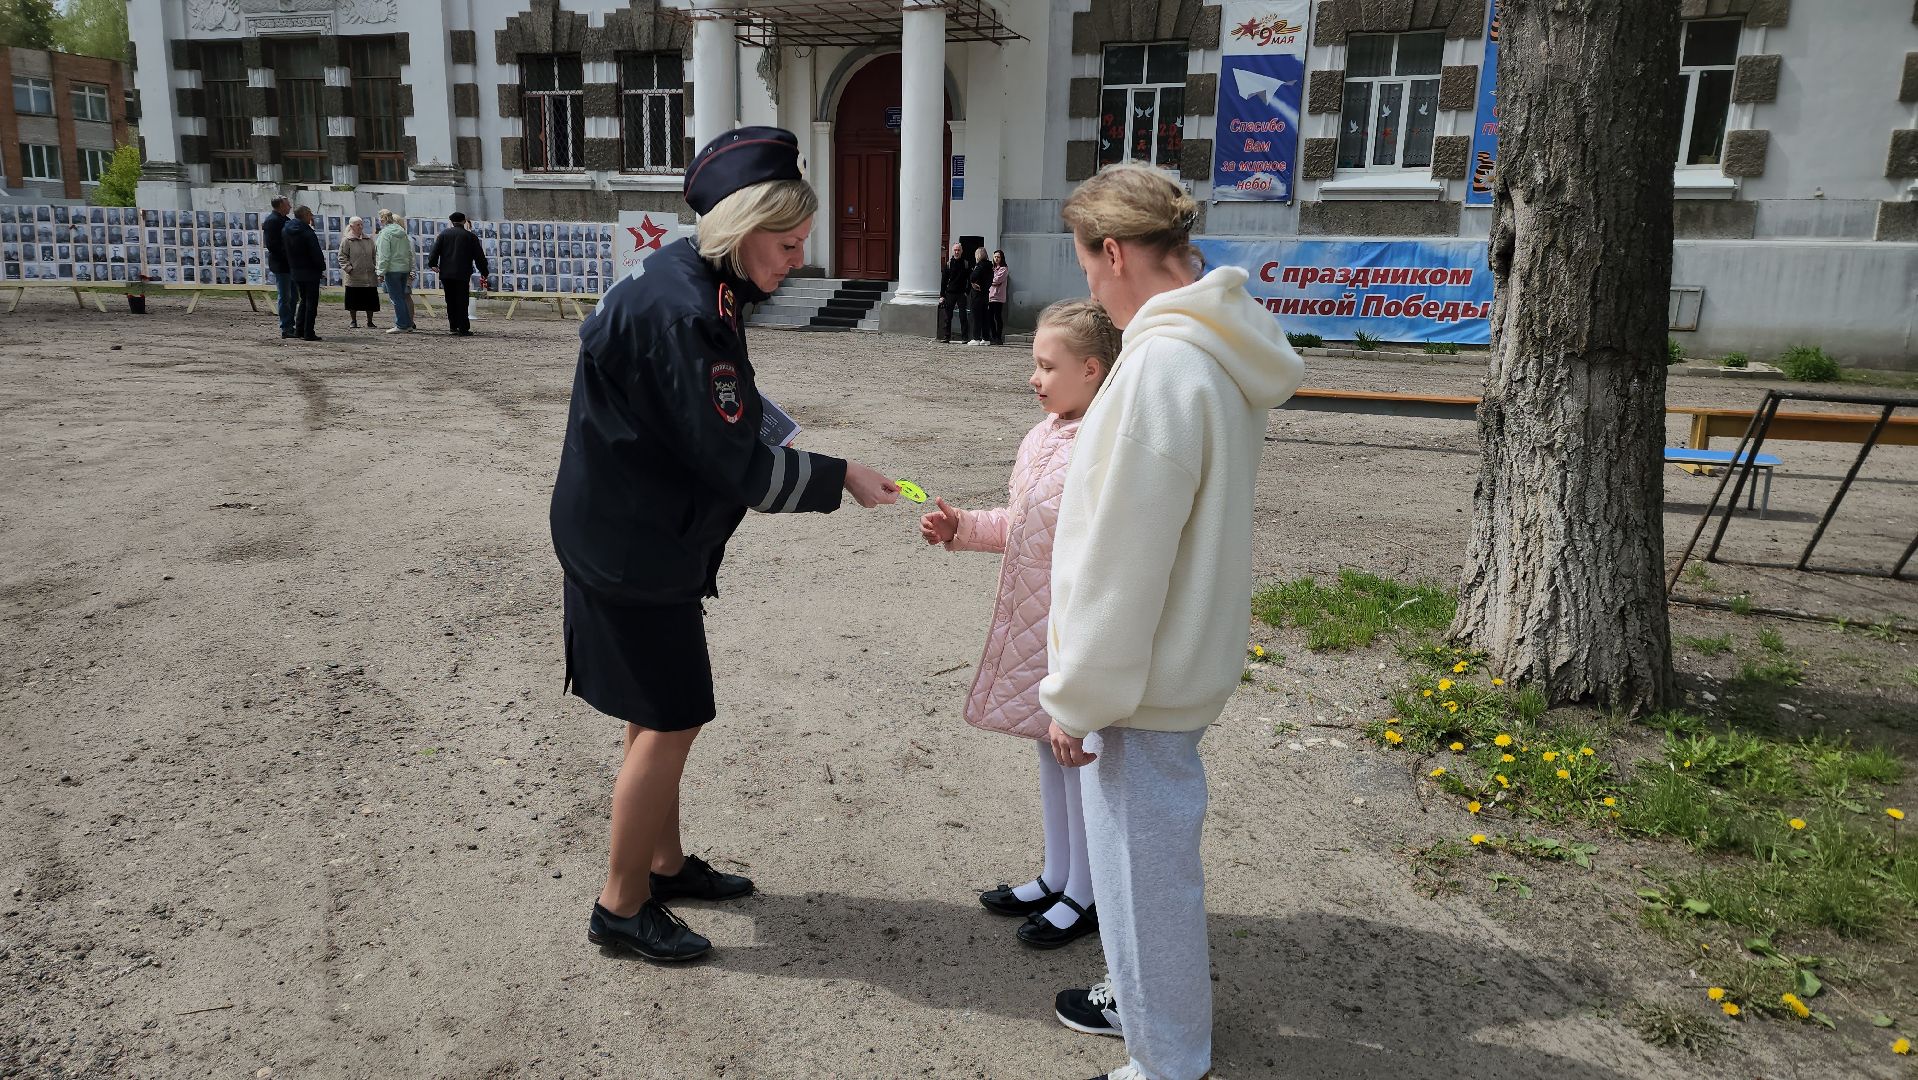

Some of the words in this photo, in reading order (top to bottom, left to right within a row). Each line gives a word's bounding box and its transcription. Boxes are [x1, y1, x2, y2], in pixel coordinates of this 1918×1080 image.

[1257, 27, 1273, 46] 9
[1271, 35, 1295, 45] МАЯ
[1230, 118, 1286, 132] Спасибо
[1243, 138, 1272, 152] Вам
[1221, 161, 1236, 171] за
[1238, 161, 1287, 173] мирное
[1235, 178, 1273, 191] небо!
[1260, 261, 1279, 283] С
[1281, 266, 1473, 289] праздником
[1253, 292, 1357, 316] ликой
[1360, 293, 1491, 323] Победы
